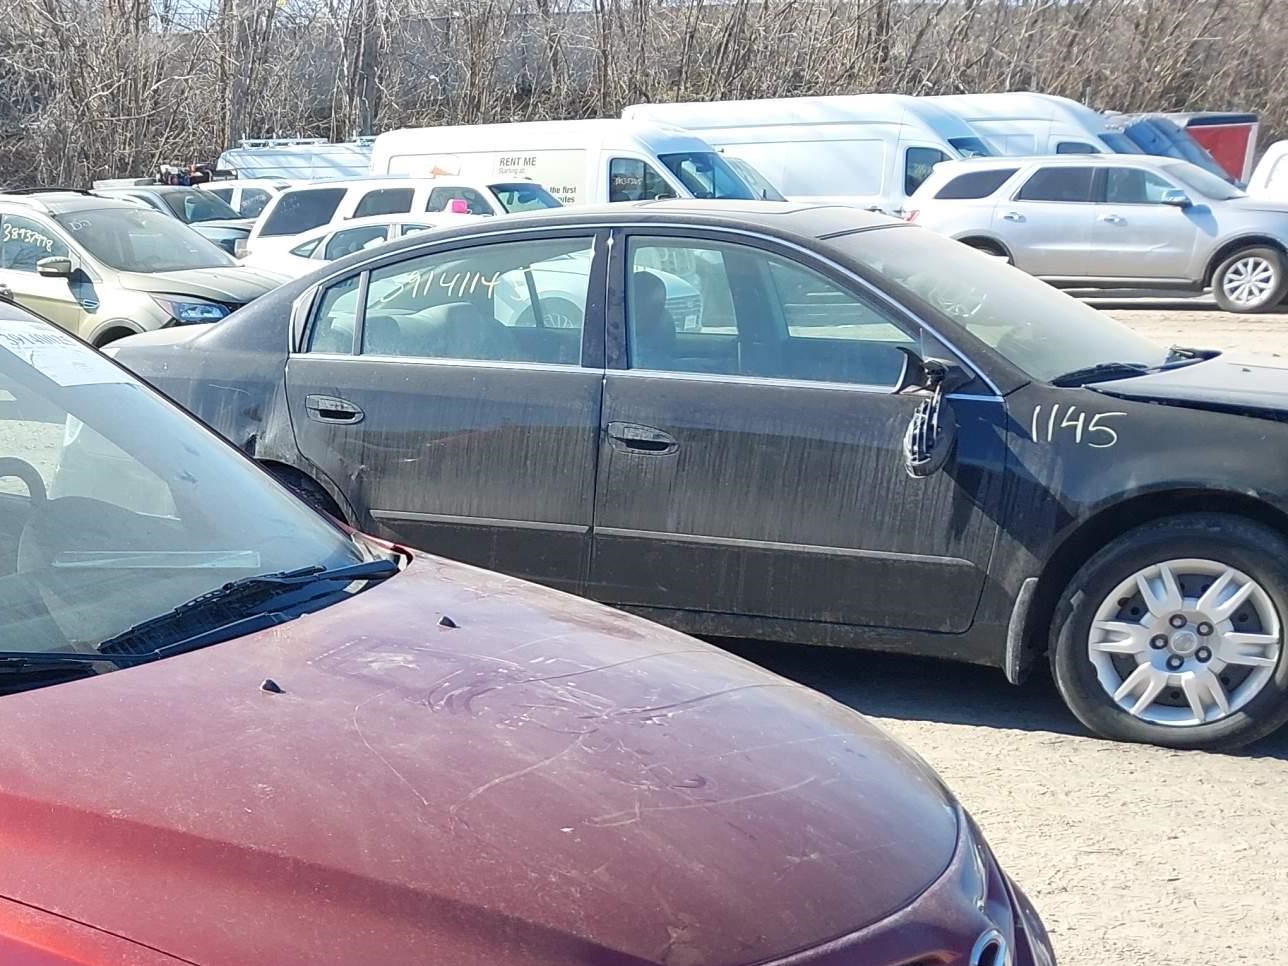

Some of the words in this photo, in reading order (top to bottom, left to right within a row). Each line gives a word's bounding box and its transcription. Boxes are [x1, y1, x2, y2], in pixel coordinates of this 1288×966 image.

[499, 157, 522, 167] RENT
[523, 156, 537, 167] ME
[549, 185, 561, 194] the
[562, 185, 577, 194] first
[1031, 403, 1128, 449] 1145
